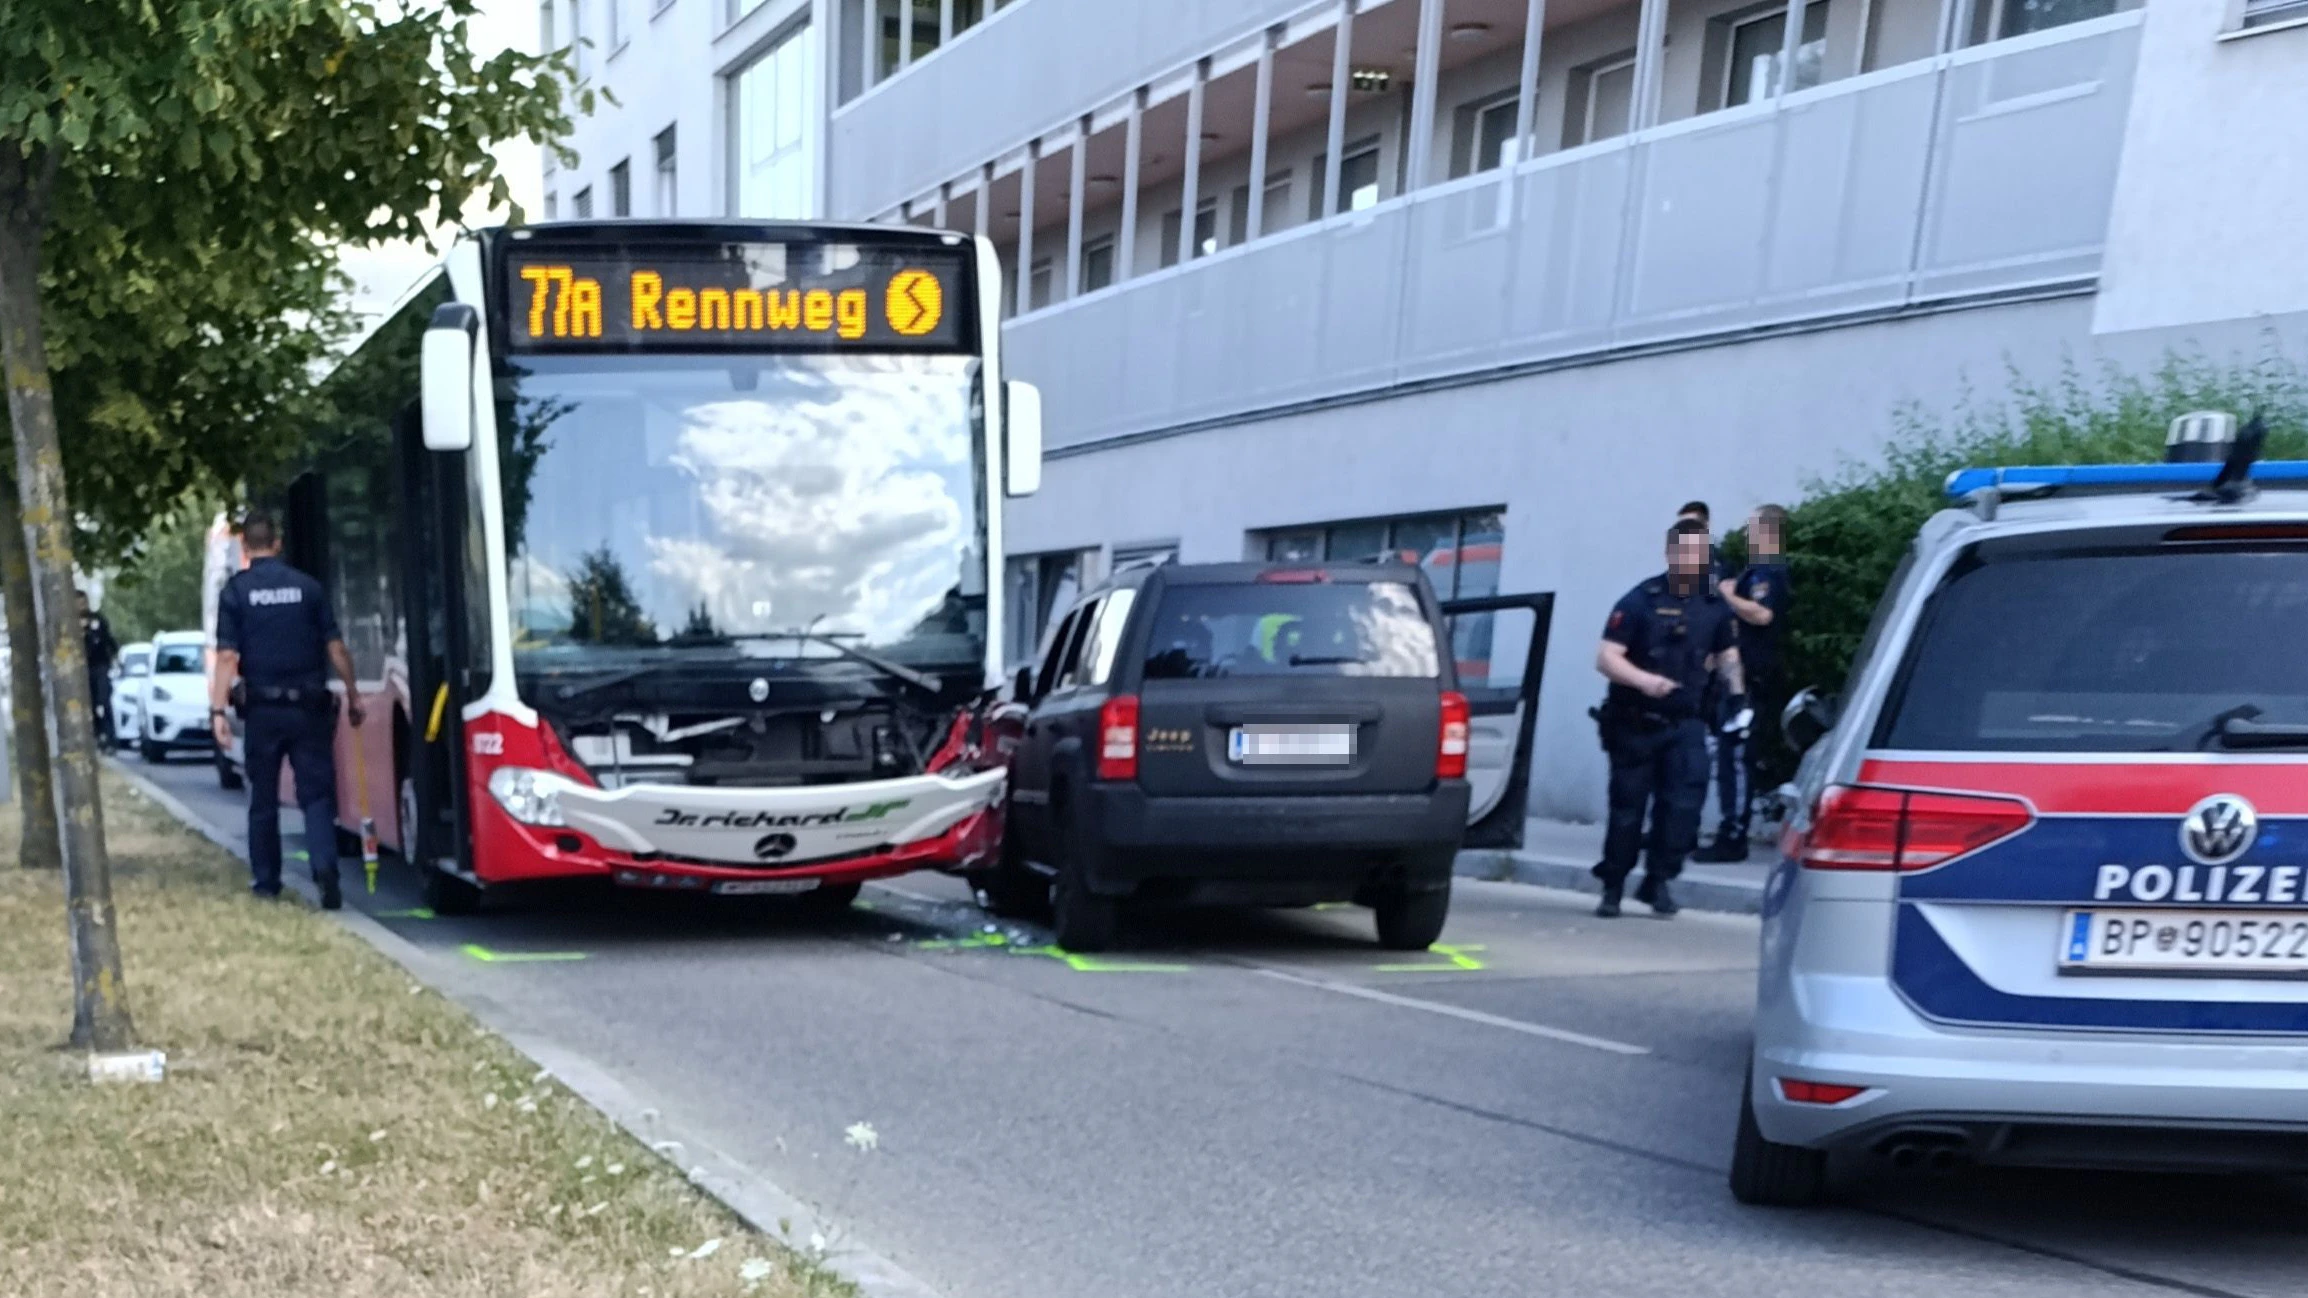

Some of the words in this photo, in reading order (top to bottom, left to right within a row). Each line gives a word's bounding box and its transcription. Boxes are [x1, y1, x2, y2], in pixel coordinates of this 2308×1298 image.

[520, 264, 603, 339] 77A
[630, 269, 867, 340] Rennweg
[1148, 728, 1191, 743] Jeep
[2093, 863, 2308, 903] POLIZE
[2102, 917, 2151, 957] BP
[2182, 919, 2308, 960] 90522
